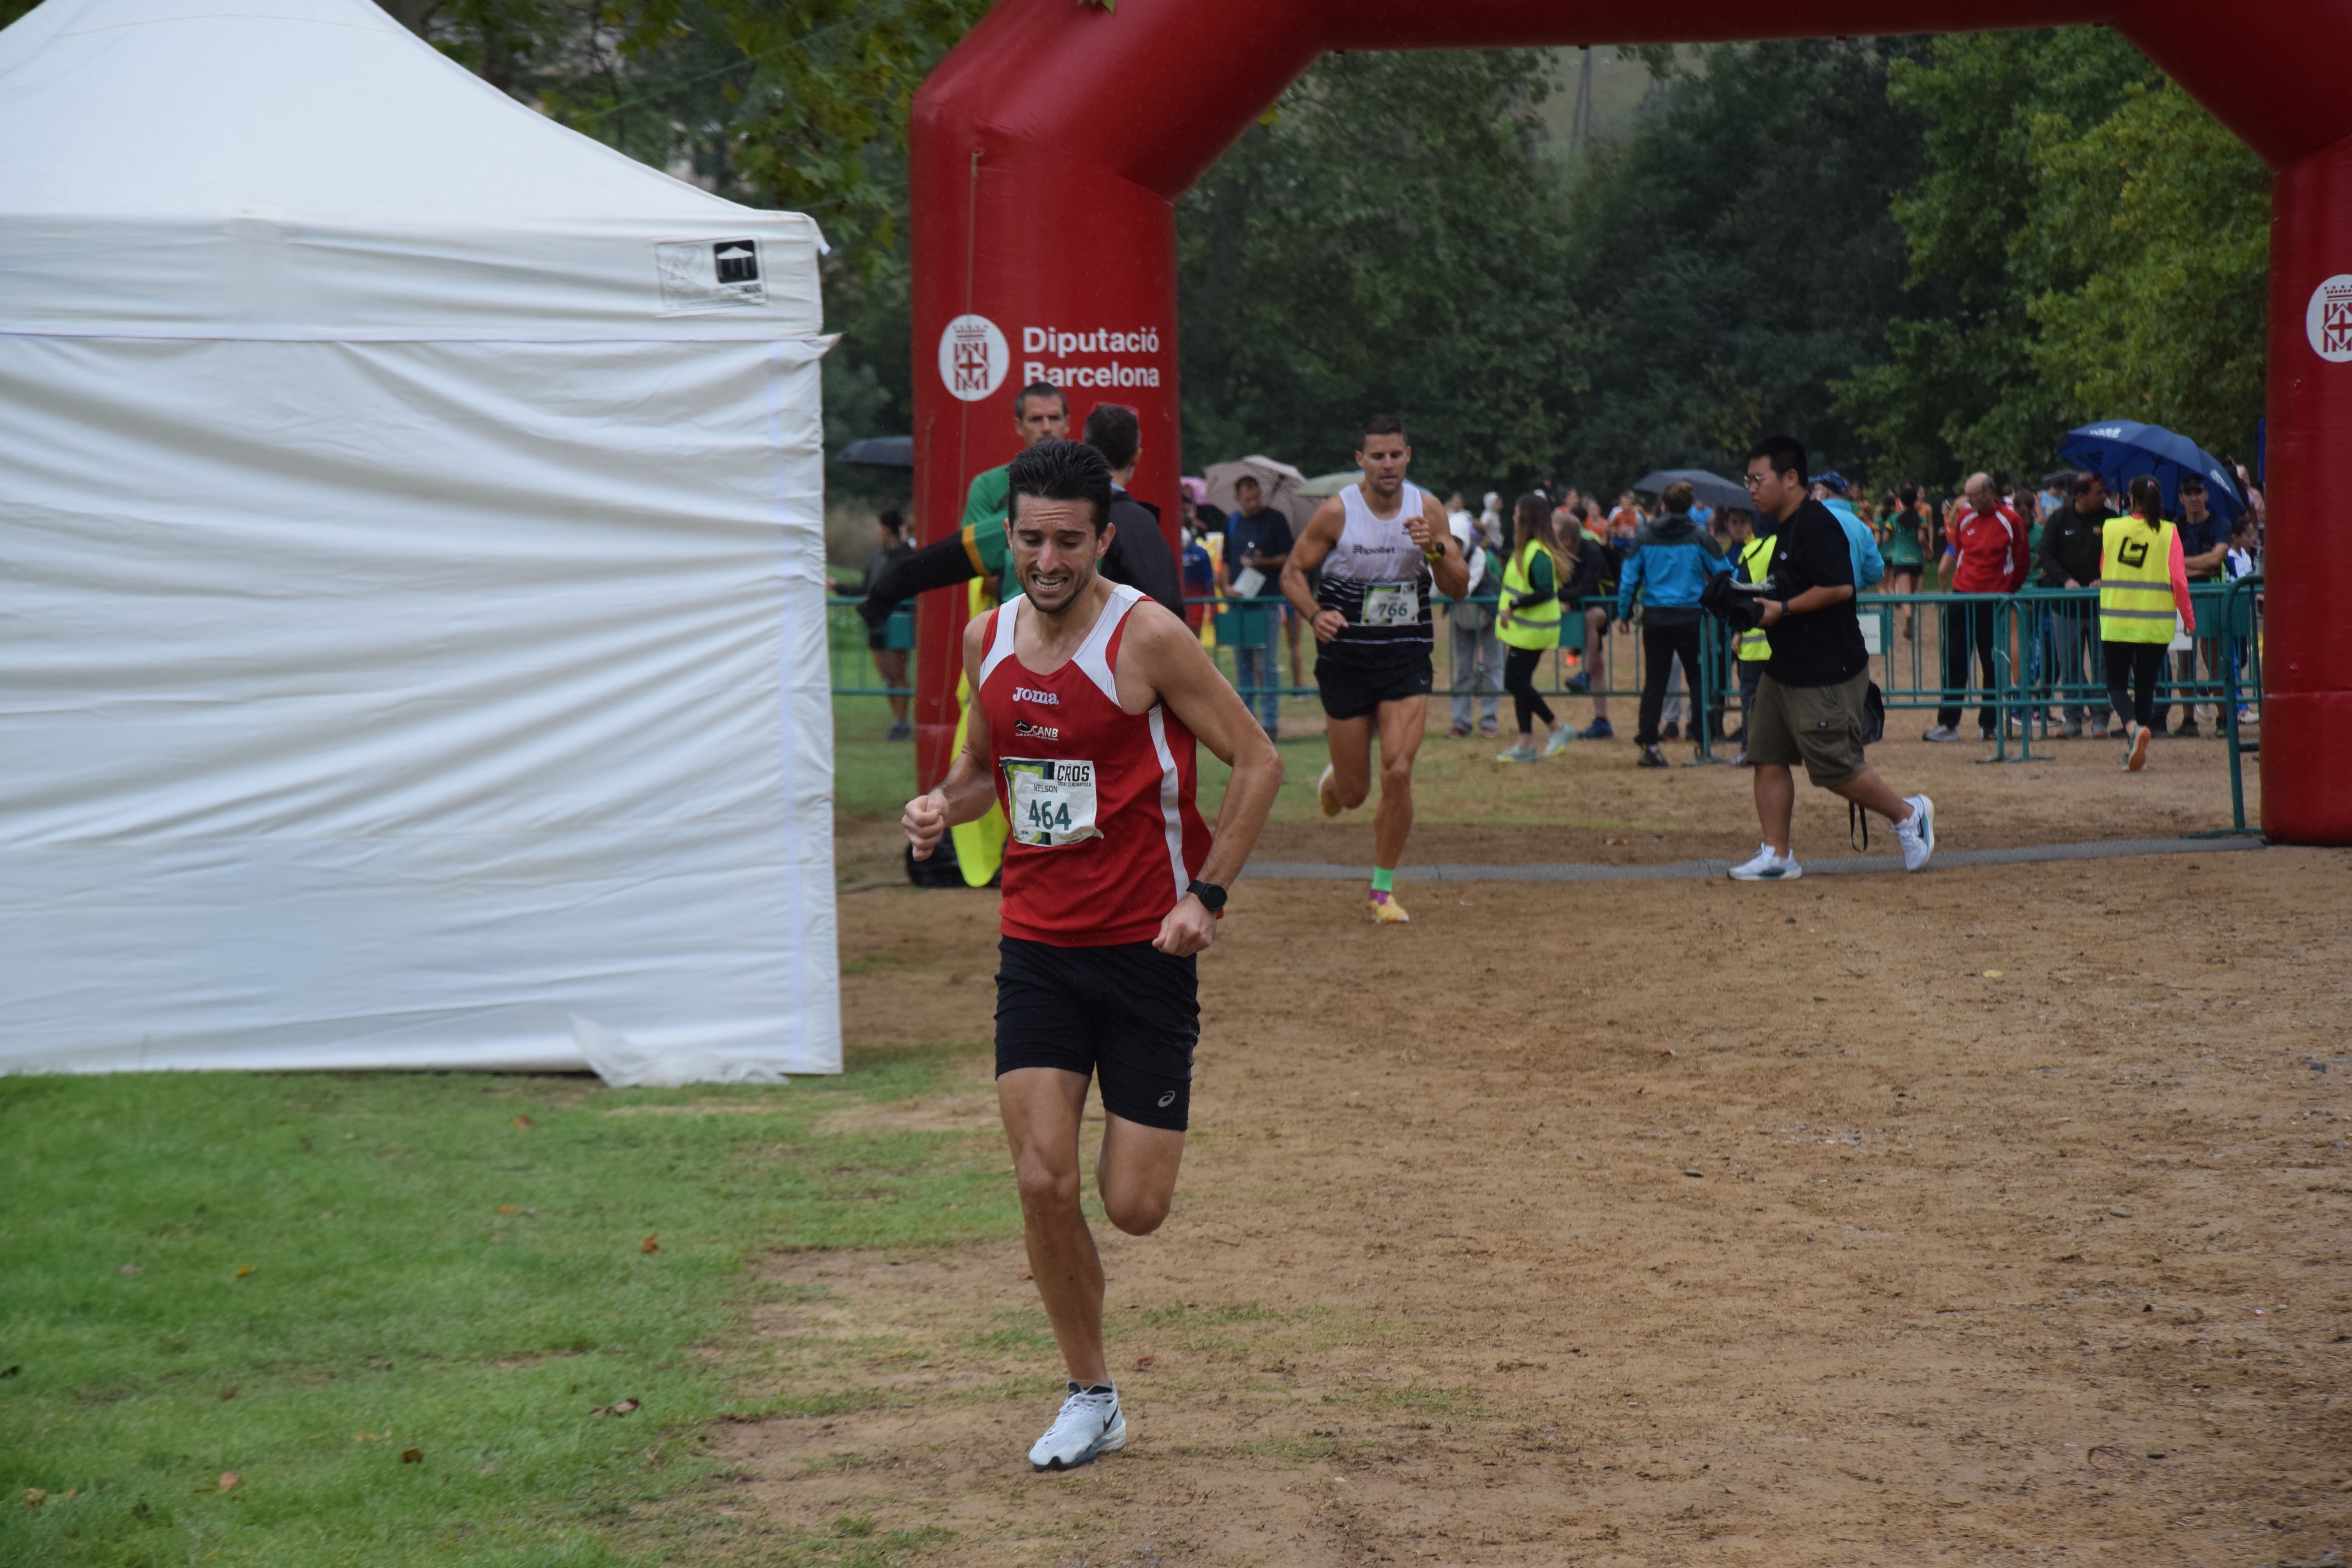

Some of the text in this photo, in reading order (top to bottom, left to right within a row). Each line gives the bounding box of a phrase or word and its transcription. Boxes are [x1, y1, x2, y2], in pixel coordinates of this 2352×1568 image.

[1023, 326, 1159, 358] Diputació
[1024, 361, 1160, 387] Barcelona
[1379, 603, 1407, 617] 766
[1032, 725, 1058, 738] CANB
[1057, 765, 1090, 782] CROS
[1033, 784, 1058, 793] NELSON
[1029, 799, 1072, 831] 464
